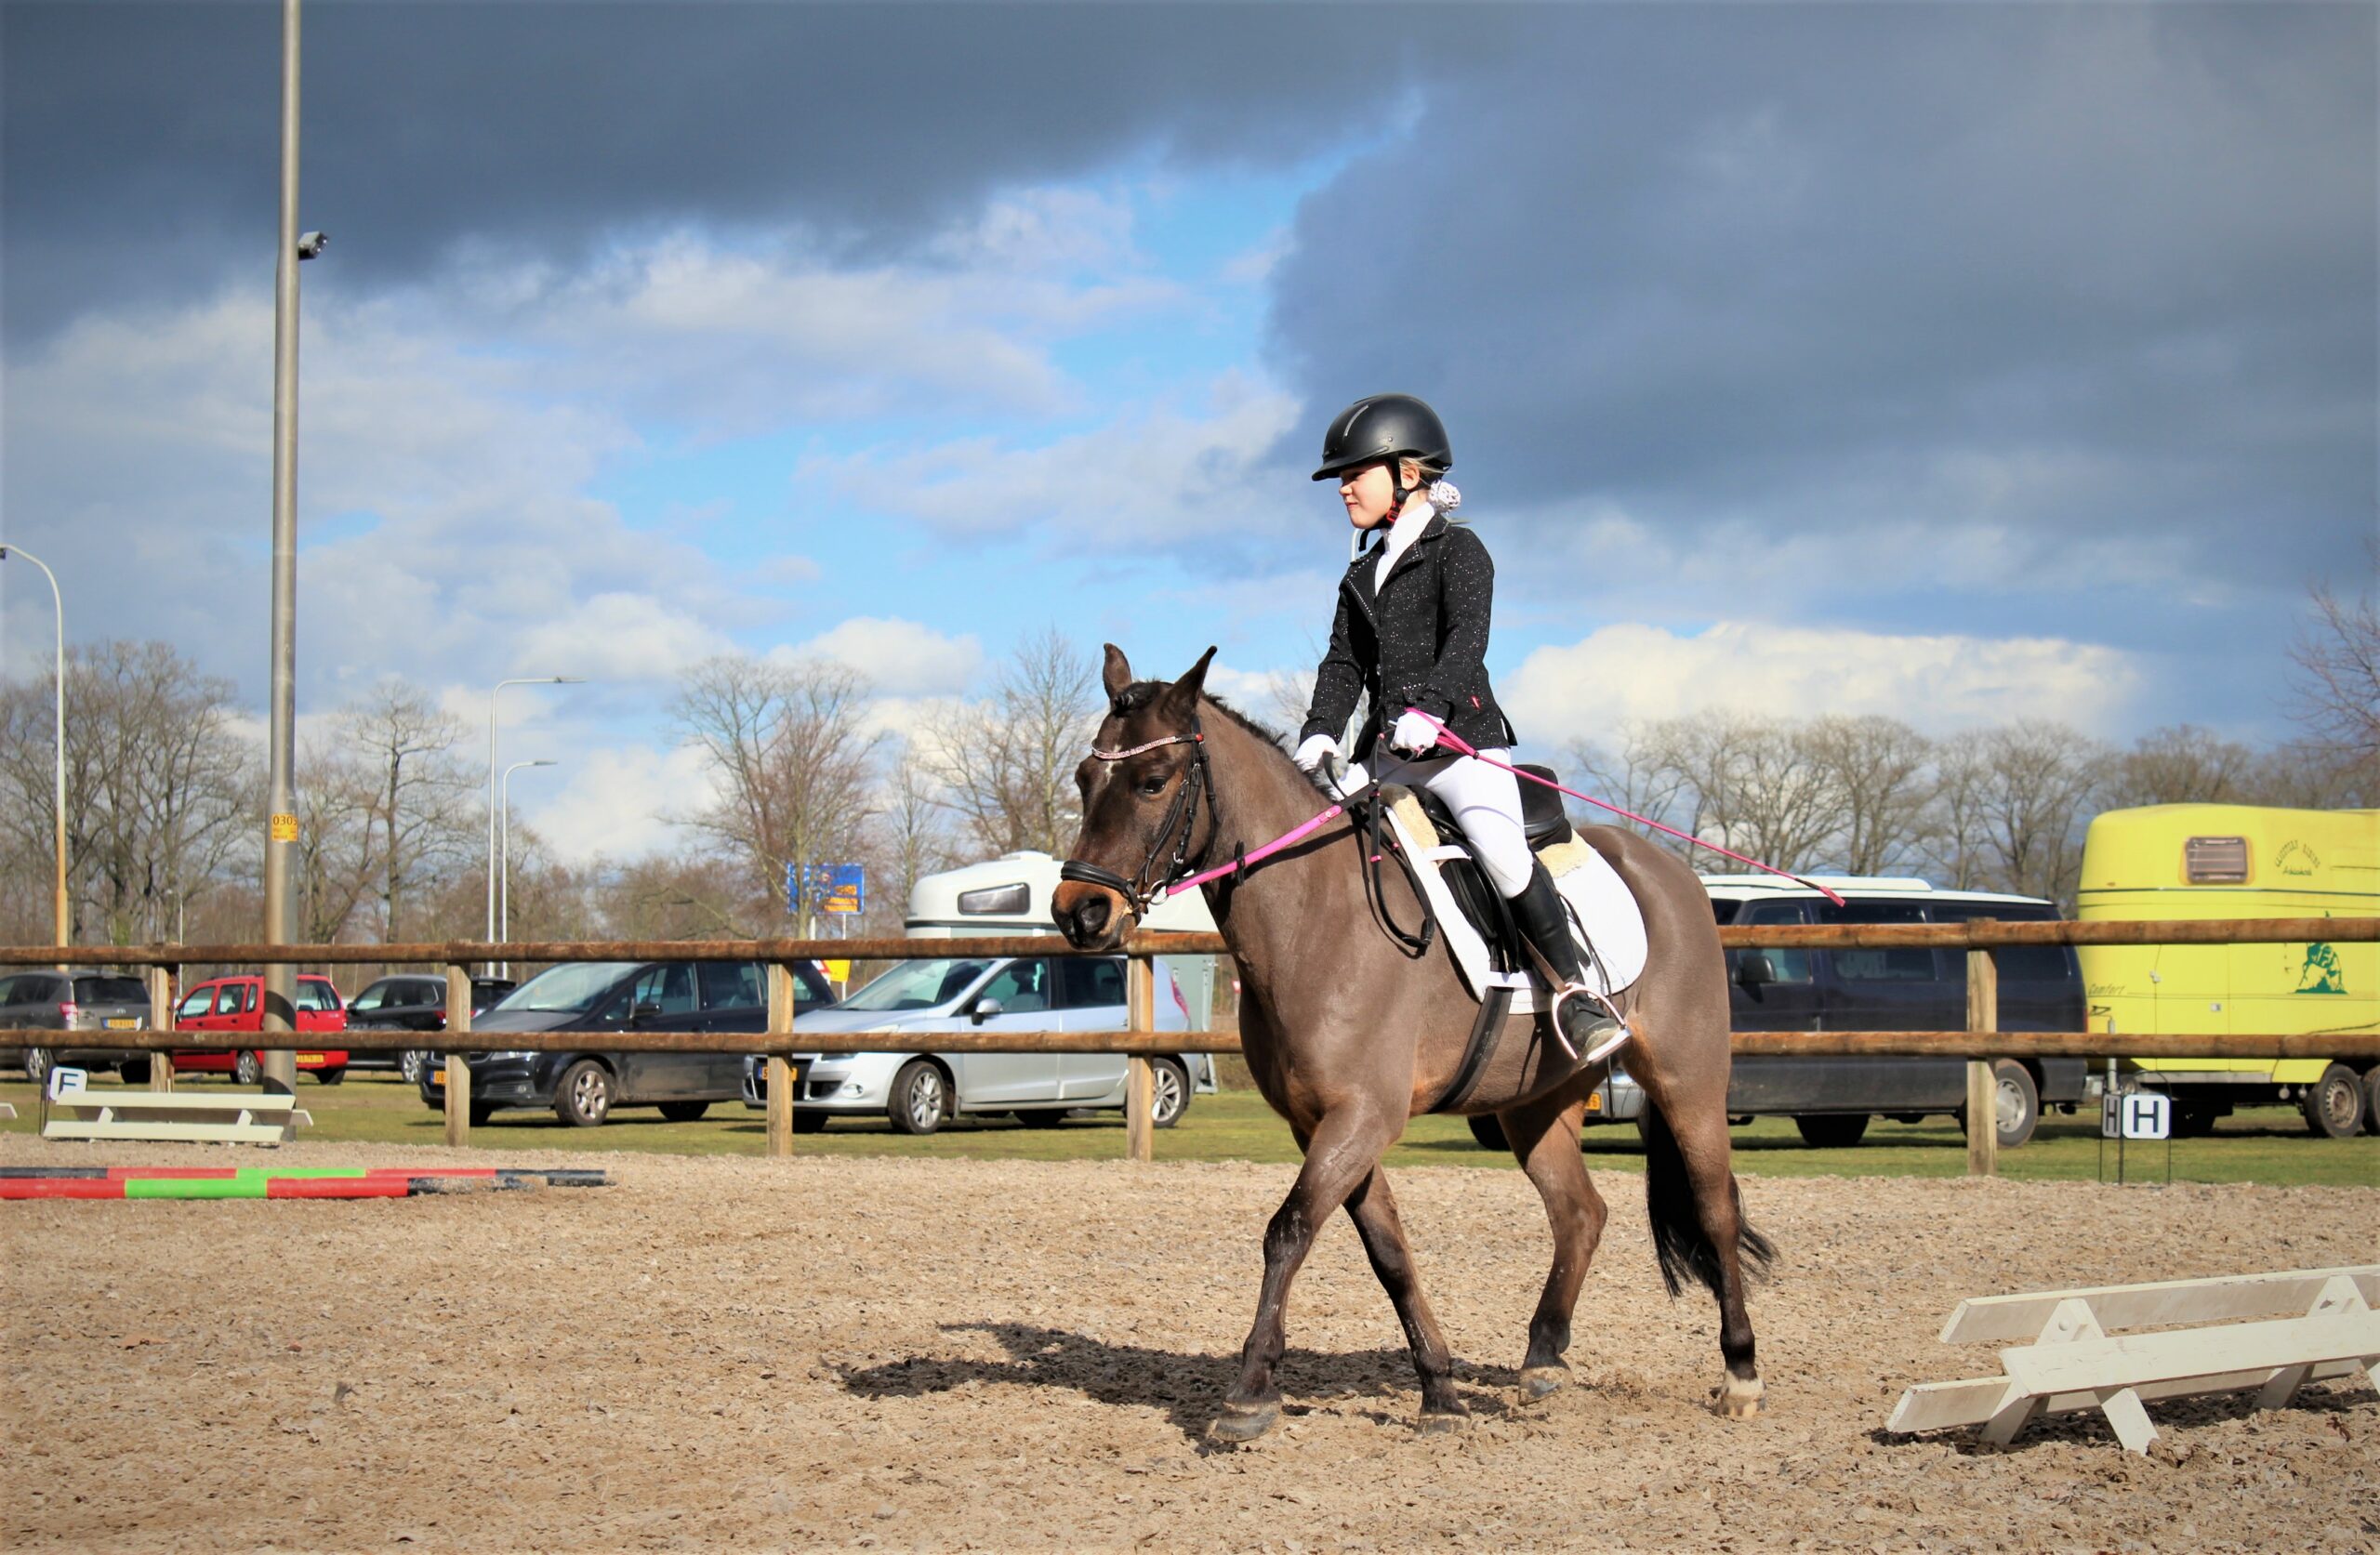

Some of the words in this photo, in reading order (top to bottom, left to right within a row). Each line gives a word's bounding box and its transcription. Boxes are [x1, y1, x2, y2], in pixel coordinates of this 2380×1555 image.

[58, 1073, 79, 1095] F
[2105, 1099, 2118, 1133] H
[2133, 1100, 2160, 1133] H
